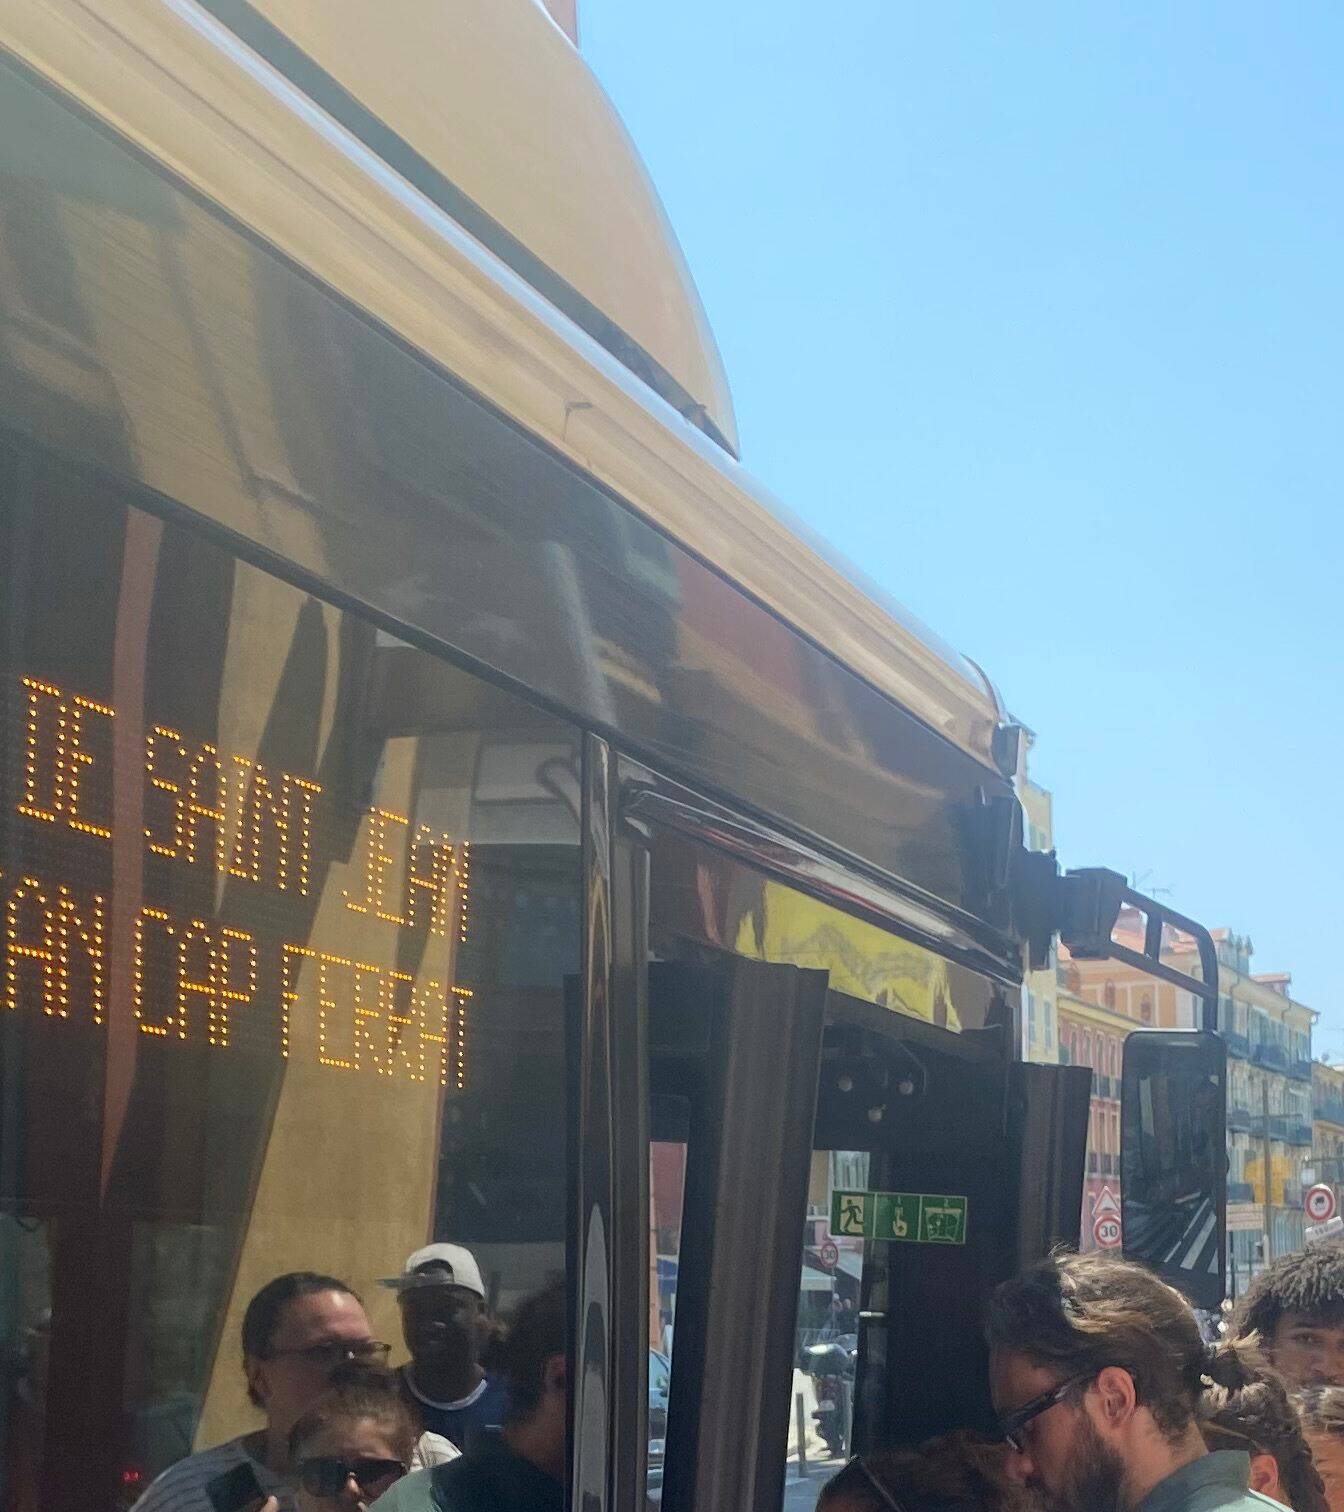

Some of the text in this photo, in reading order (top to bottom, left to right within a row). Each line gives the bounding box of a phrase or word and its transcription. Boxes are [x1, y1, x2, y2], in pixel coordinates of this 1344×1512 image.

[17, 677, 117, 838] DE
[143, 725, 323, 896] SAINT
[341, 806, 471, 942] JEAN
[134, 906, 257, 1048] CAP
[282, 943, 474, 1089] FERRAT
[1100, 1224, 1118, 1238] 30
